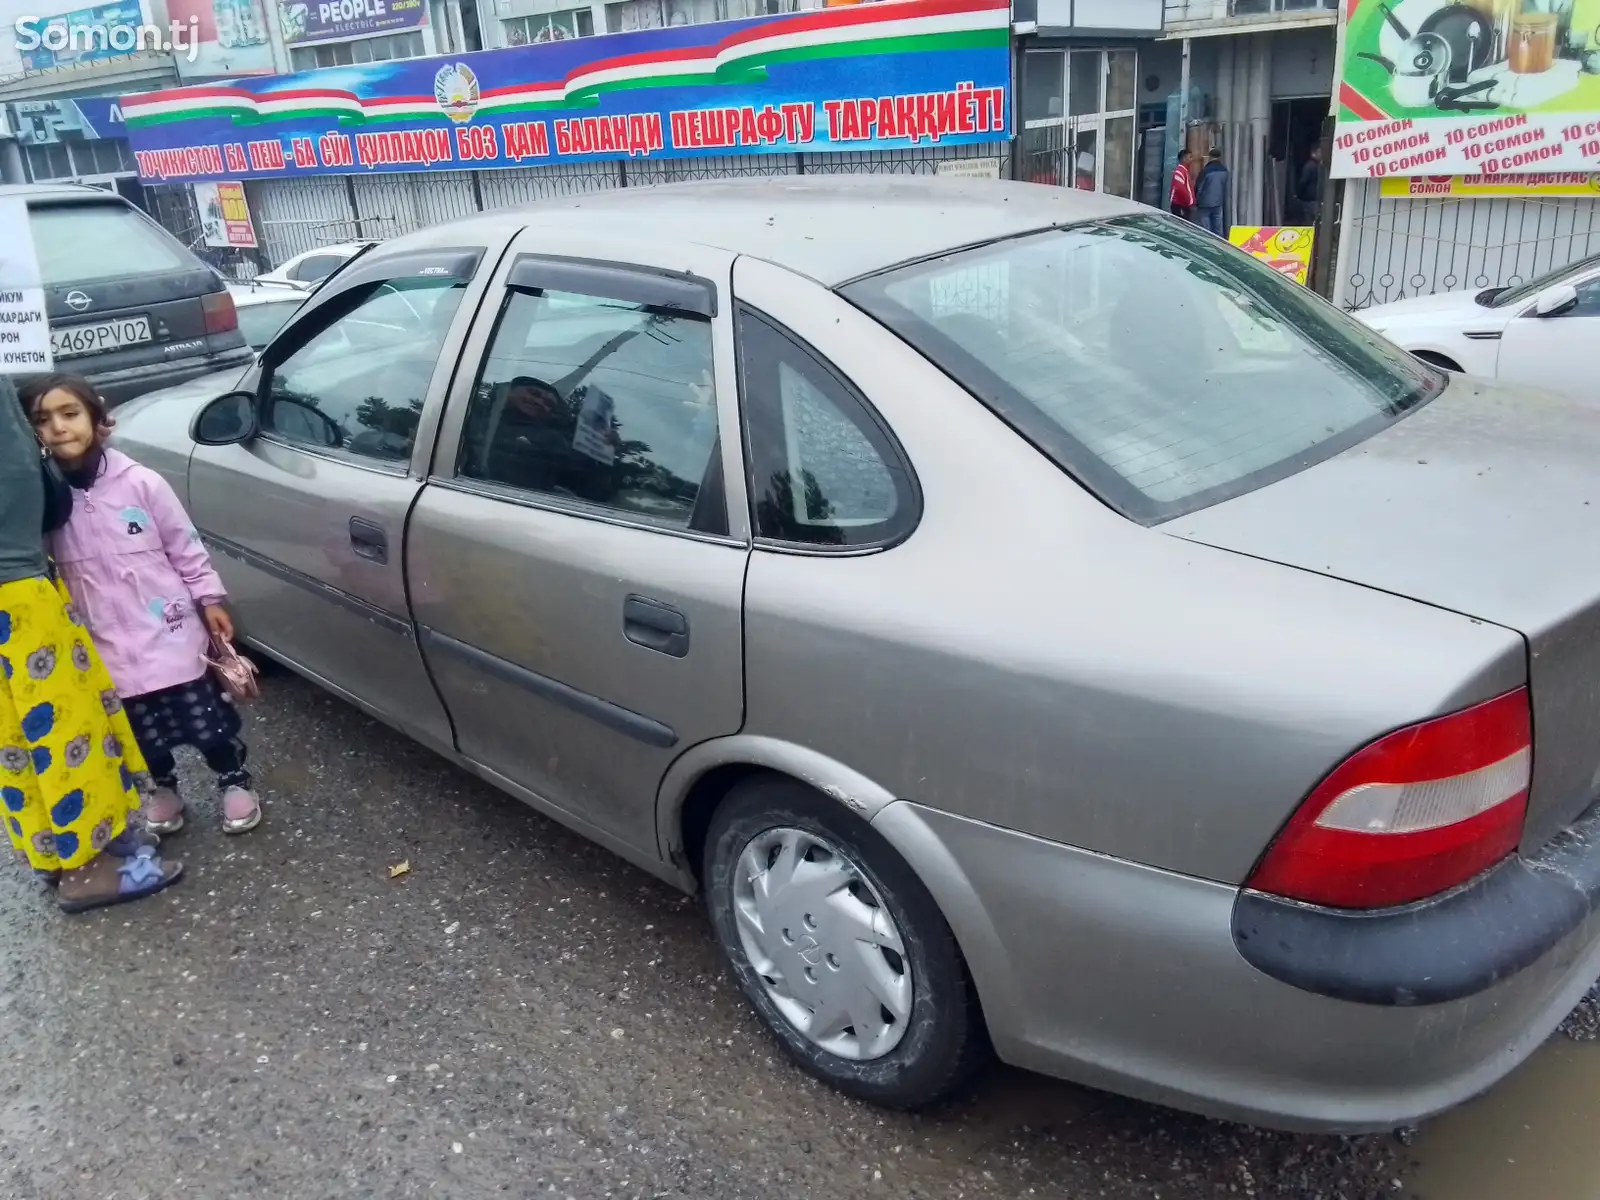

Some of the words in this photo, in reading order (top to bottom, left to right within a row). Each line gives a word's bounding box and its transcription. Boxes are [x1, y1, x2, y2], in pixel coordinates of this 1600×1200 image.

[319, 0, 386, 23] PEOPLE
[335, 19, 374, 33] ELECTRIC
[135, 144, 224, 179] ТОҶИКИСТОН
[224, 143, 248, 172] БА
[248, 140, 285, 170] ПЕШ
[292, 137, 317, 168] БА
[455, 125, 498, 160] БОЗ
[502, 121, 549, 161] ҲАМ
[554, 111, 664, 157] БАЛАНДИ
[670, 102, 815, 149] ПЕШРАФТУ
[823, 81, 1005, 143] ТАРАҚҚИЁТ!
[1445, 129, 1464, 145] 10
[1561, 125, 1582, 142] 10
[1335, 133, 1354, 149] 10
[1352, 148, 1370, 164] 10
[1461, 143, 1481, 160] 10
[1367, 162, 1386, 177] 10
[1478, 158, 1499, 174] 10
[1409, 184, 1451, 194] СОМОН
[4, 351, 45, 363] КУНЕТОН
